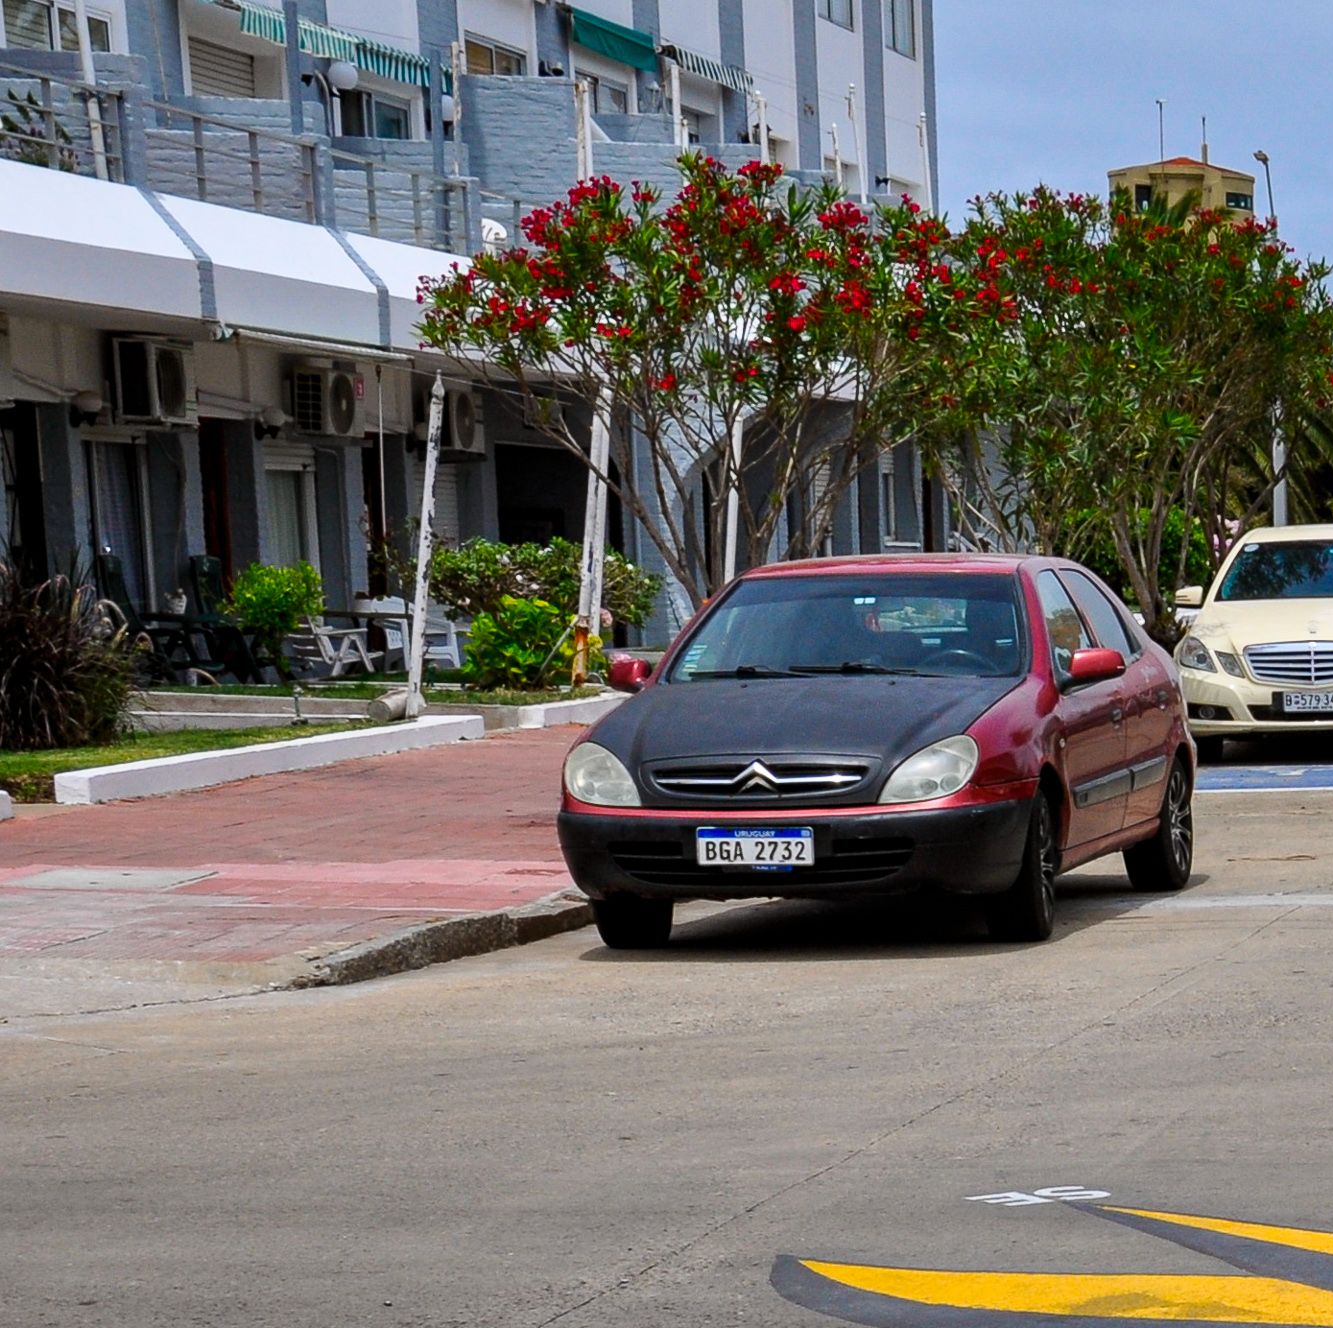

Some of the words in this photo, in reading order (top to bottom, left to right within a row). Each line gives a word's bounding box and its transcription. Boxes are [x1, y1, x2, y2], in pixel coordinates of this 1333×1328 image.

[1301, 694, 1321, 706] 579
[734, 830, 776, 838] URUGUAY
[705, 841, 744, 861] BGA
[754, 841, 806, 861] 2732
